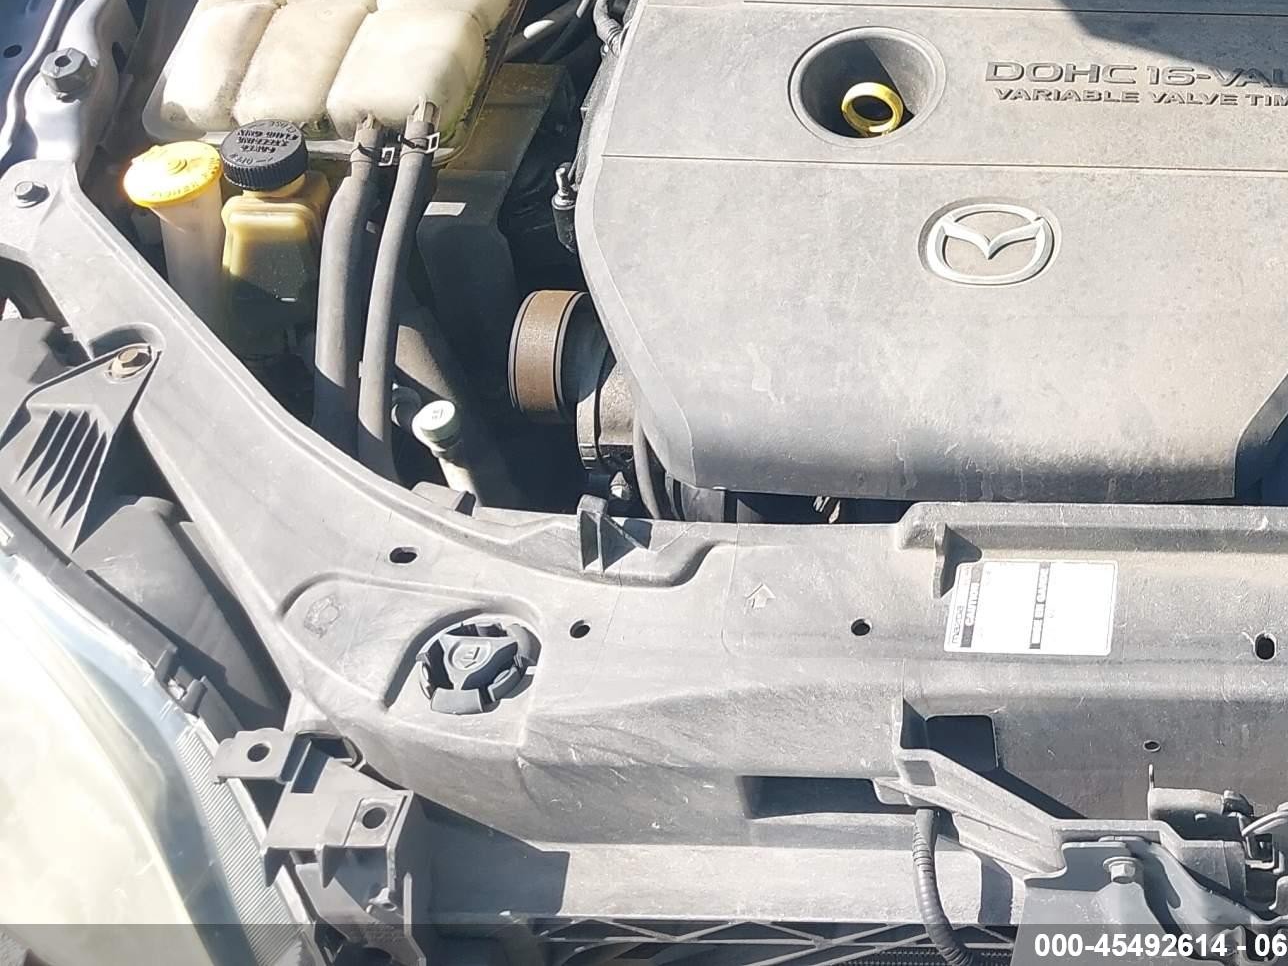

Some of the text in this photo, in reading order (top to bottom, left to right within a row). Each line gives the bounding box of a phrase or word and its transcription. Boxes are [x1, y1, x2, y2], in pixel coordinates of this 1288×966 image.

[985, 61, 1137, 85] DOHC
[995, 87, 1140, 104] VARIABLE
[1149, 91, 1239, 107] VALVE
[963, 582, 980, 627] CAUTION
